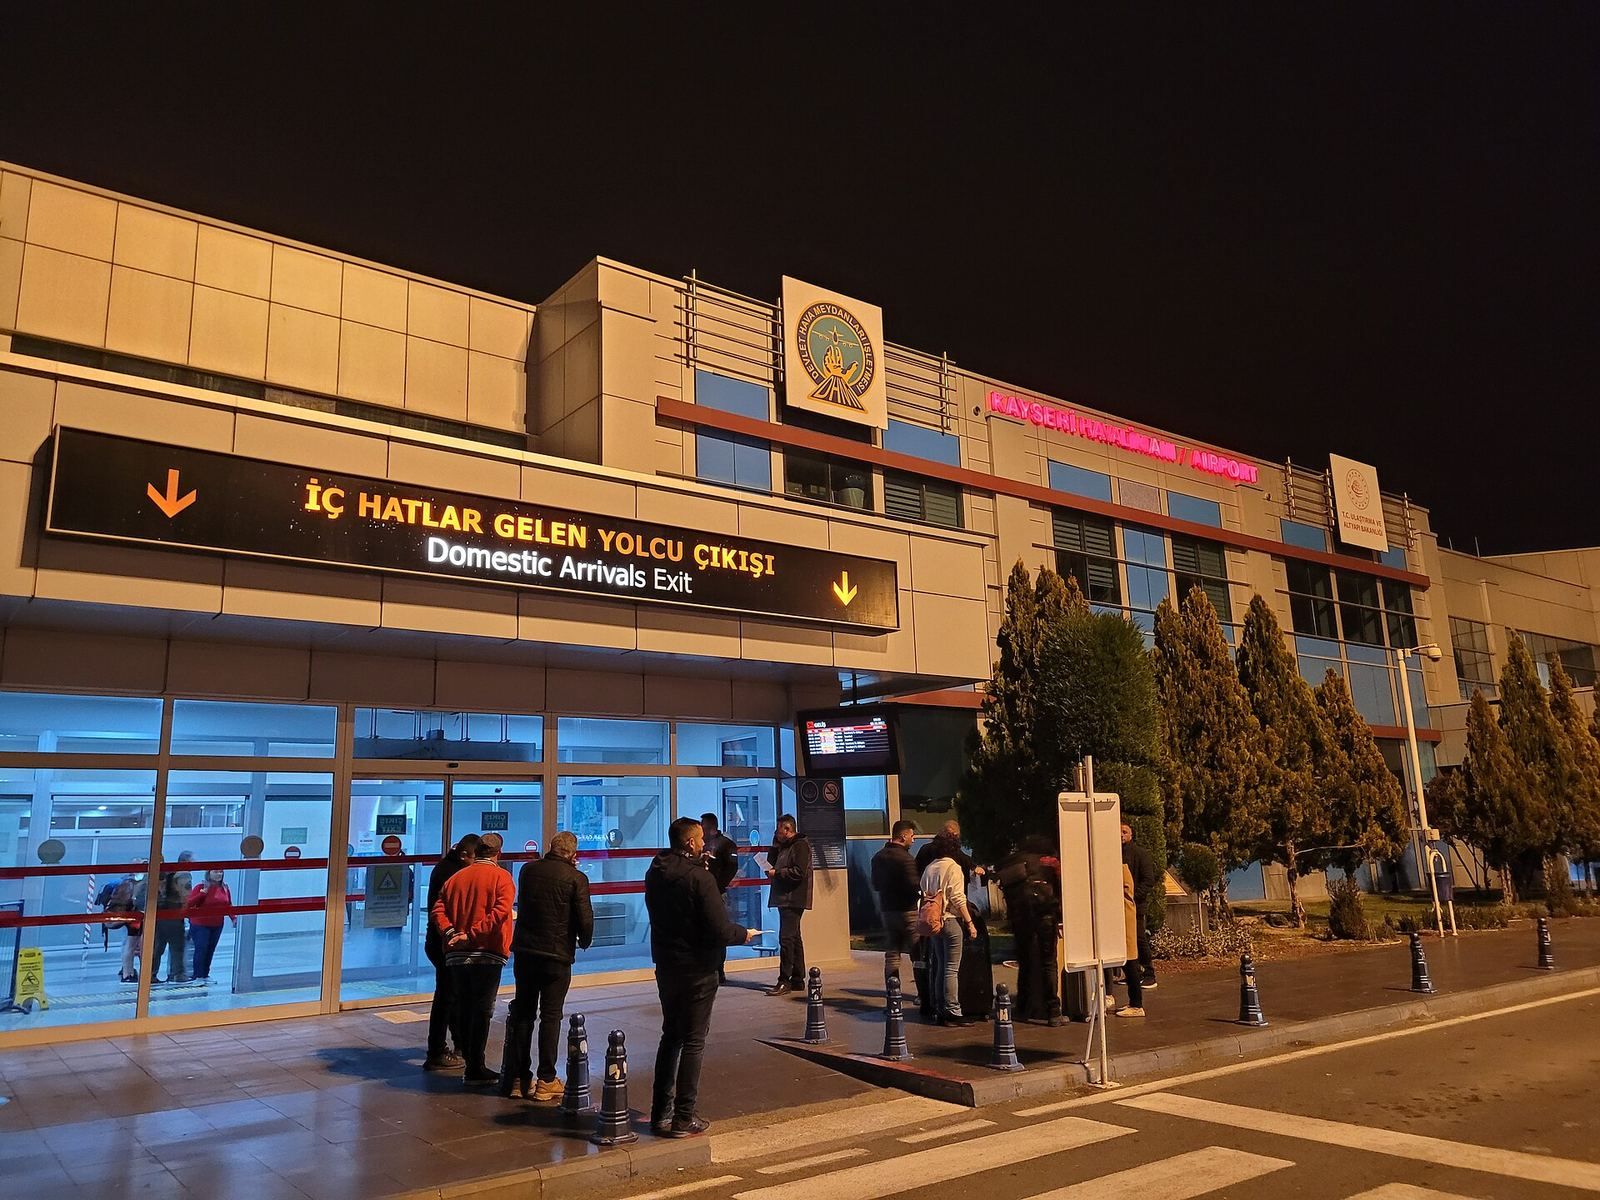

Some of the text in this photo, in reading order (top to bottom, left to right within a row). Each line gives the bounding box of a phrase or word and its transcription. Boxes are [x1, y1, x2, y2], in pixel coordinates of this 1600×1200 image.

[798, 311, 816, 337] HAVA
[814, 304, 867, 342] MEYDANLARI
[798, 338, 818, 383] DEVLET
[989, 391, 1077, 435] KAYSERİ
[1190, 449, 1258, 484] AIRPORT
[304, 477, 776, 578] İÇ HATLAR GELEN YOLCU ÇIKIŞI
[427, 537, 693, 594] Domestic Arrivals Exit
